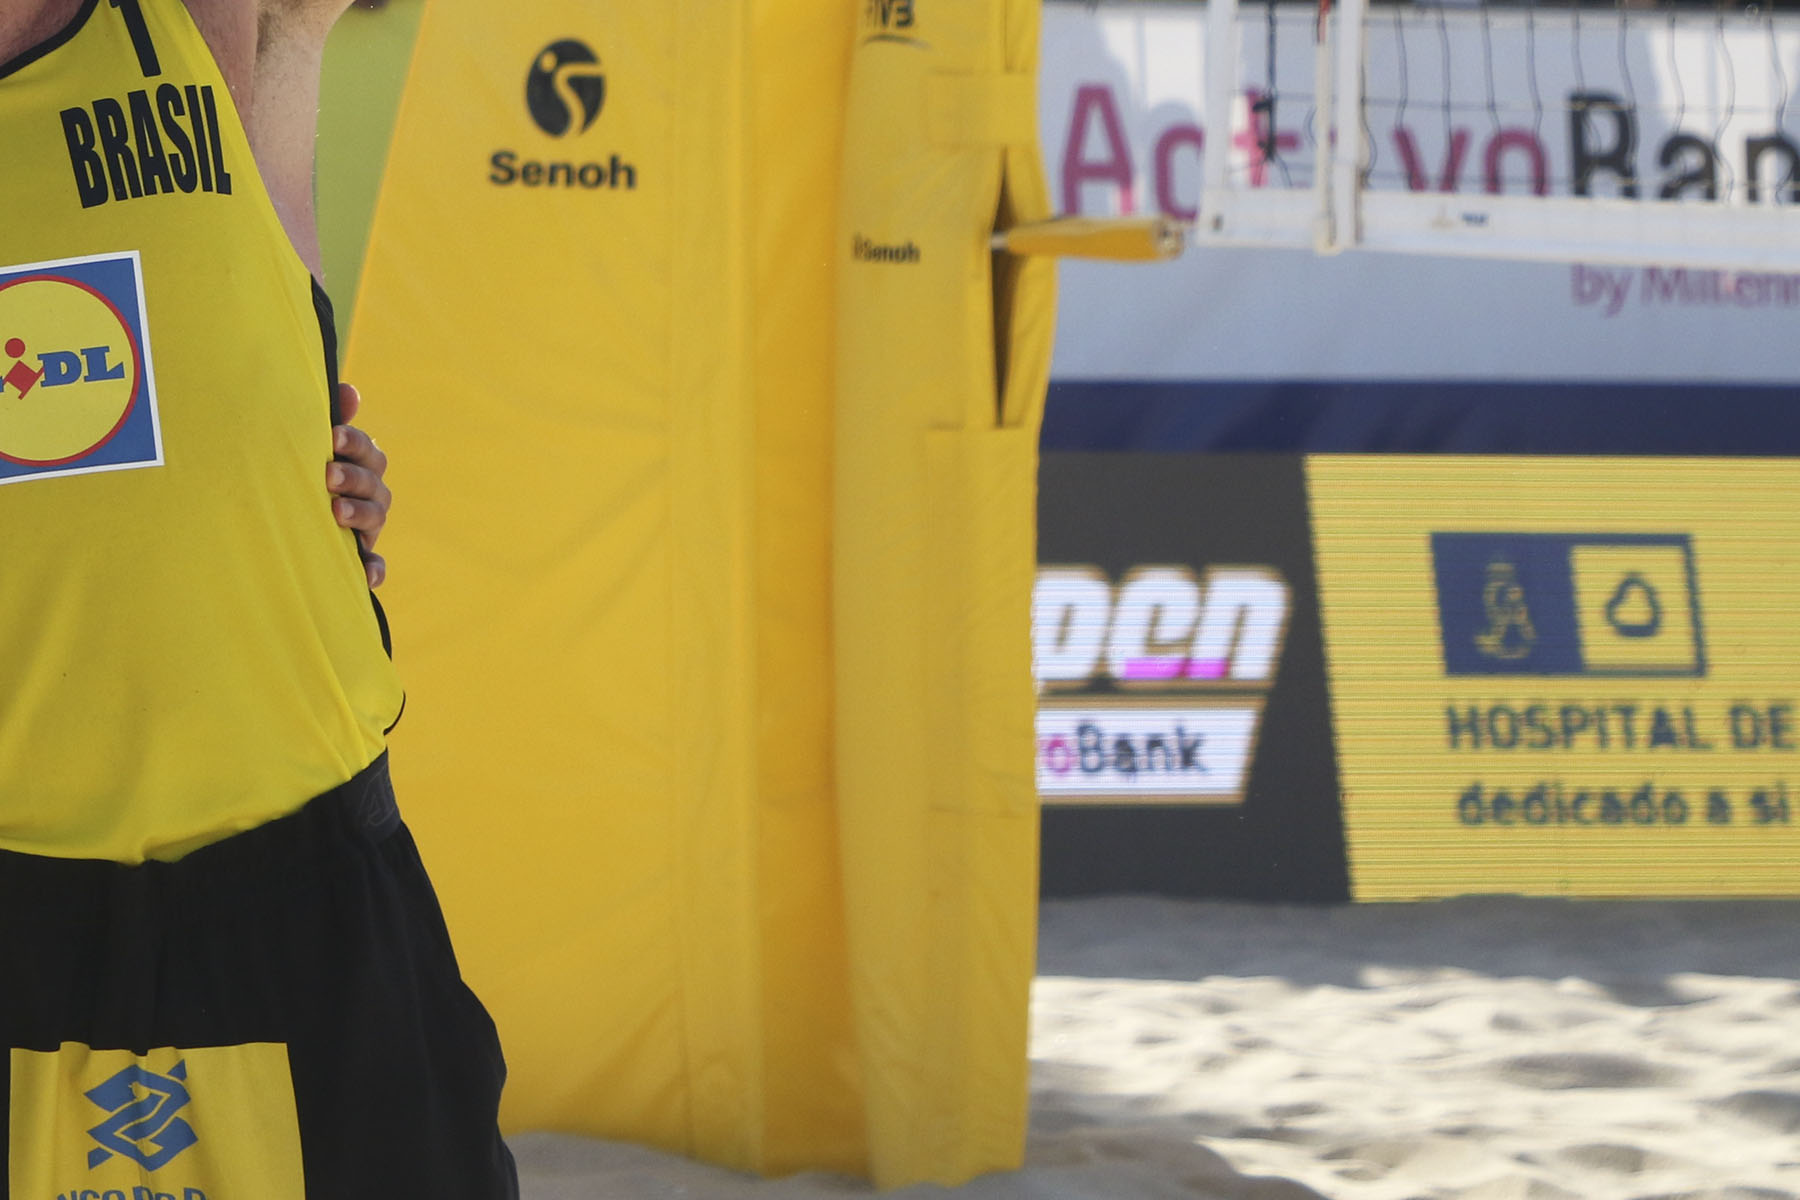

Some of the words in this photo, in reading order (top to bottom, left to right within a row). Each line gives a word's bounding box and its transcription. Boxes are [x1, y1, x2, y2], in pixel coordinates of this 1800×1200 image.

[60, 83, 233, 209] BRASIL
[488, 150, 637, 190] Senoh
[861, 240, 920, 263] Senoh
[1571, 264, 1633, 318] by
[1038, 718, 1207, 776] oBank
[1446, 702, 1713, 751] HOSPITAL
[1729, 702, 1797, 751] DE
[1457, 780, 1690, 827] dedicado
